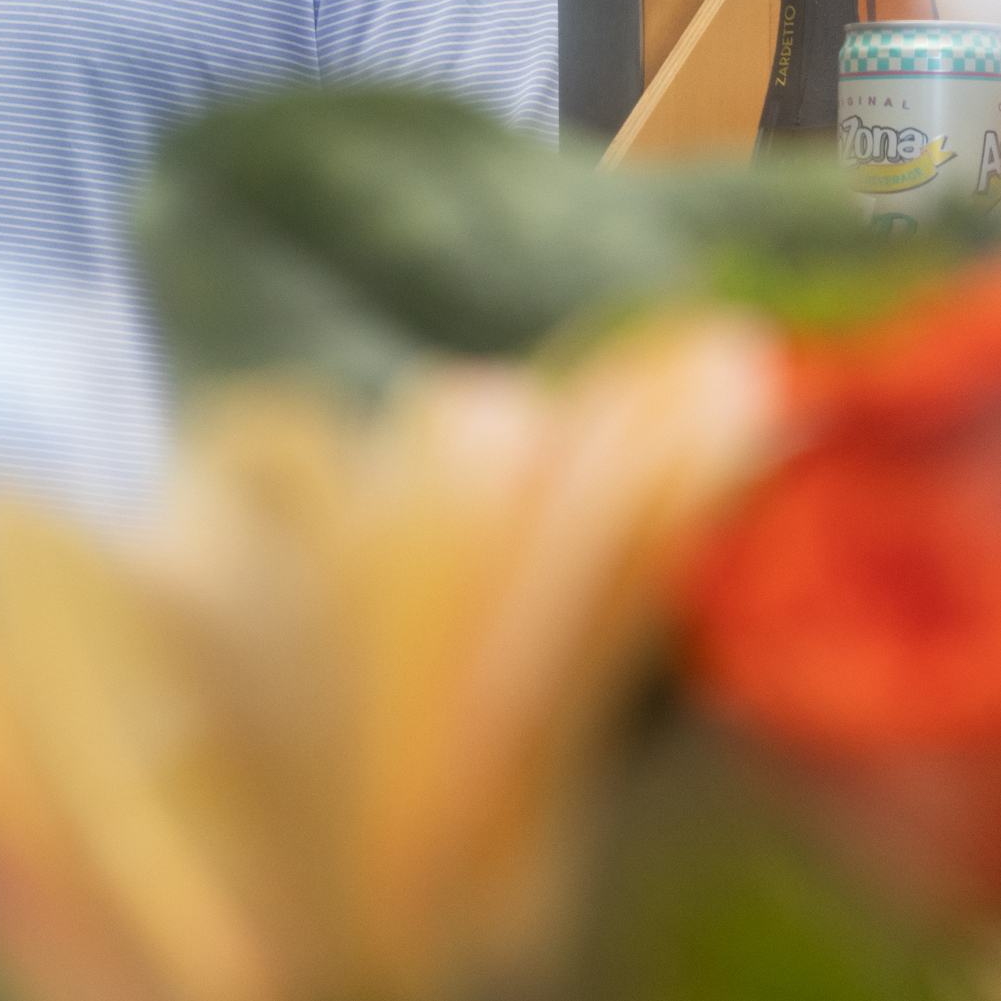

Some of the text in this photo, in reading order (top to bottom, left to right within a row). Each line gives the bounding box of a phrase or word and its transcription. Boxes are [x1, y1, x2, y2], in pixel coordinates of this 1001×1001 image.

[775, 5, 796, 86] ZARDETTO
[838, 96, 910, 110] IGINAL
[839, 115, 928, 163] Zona
